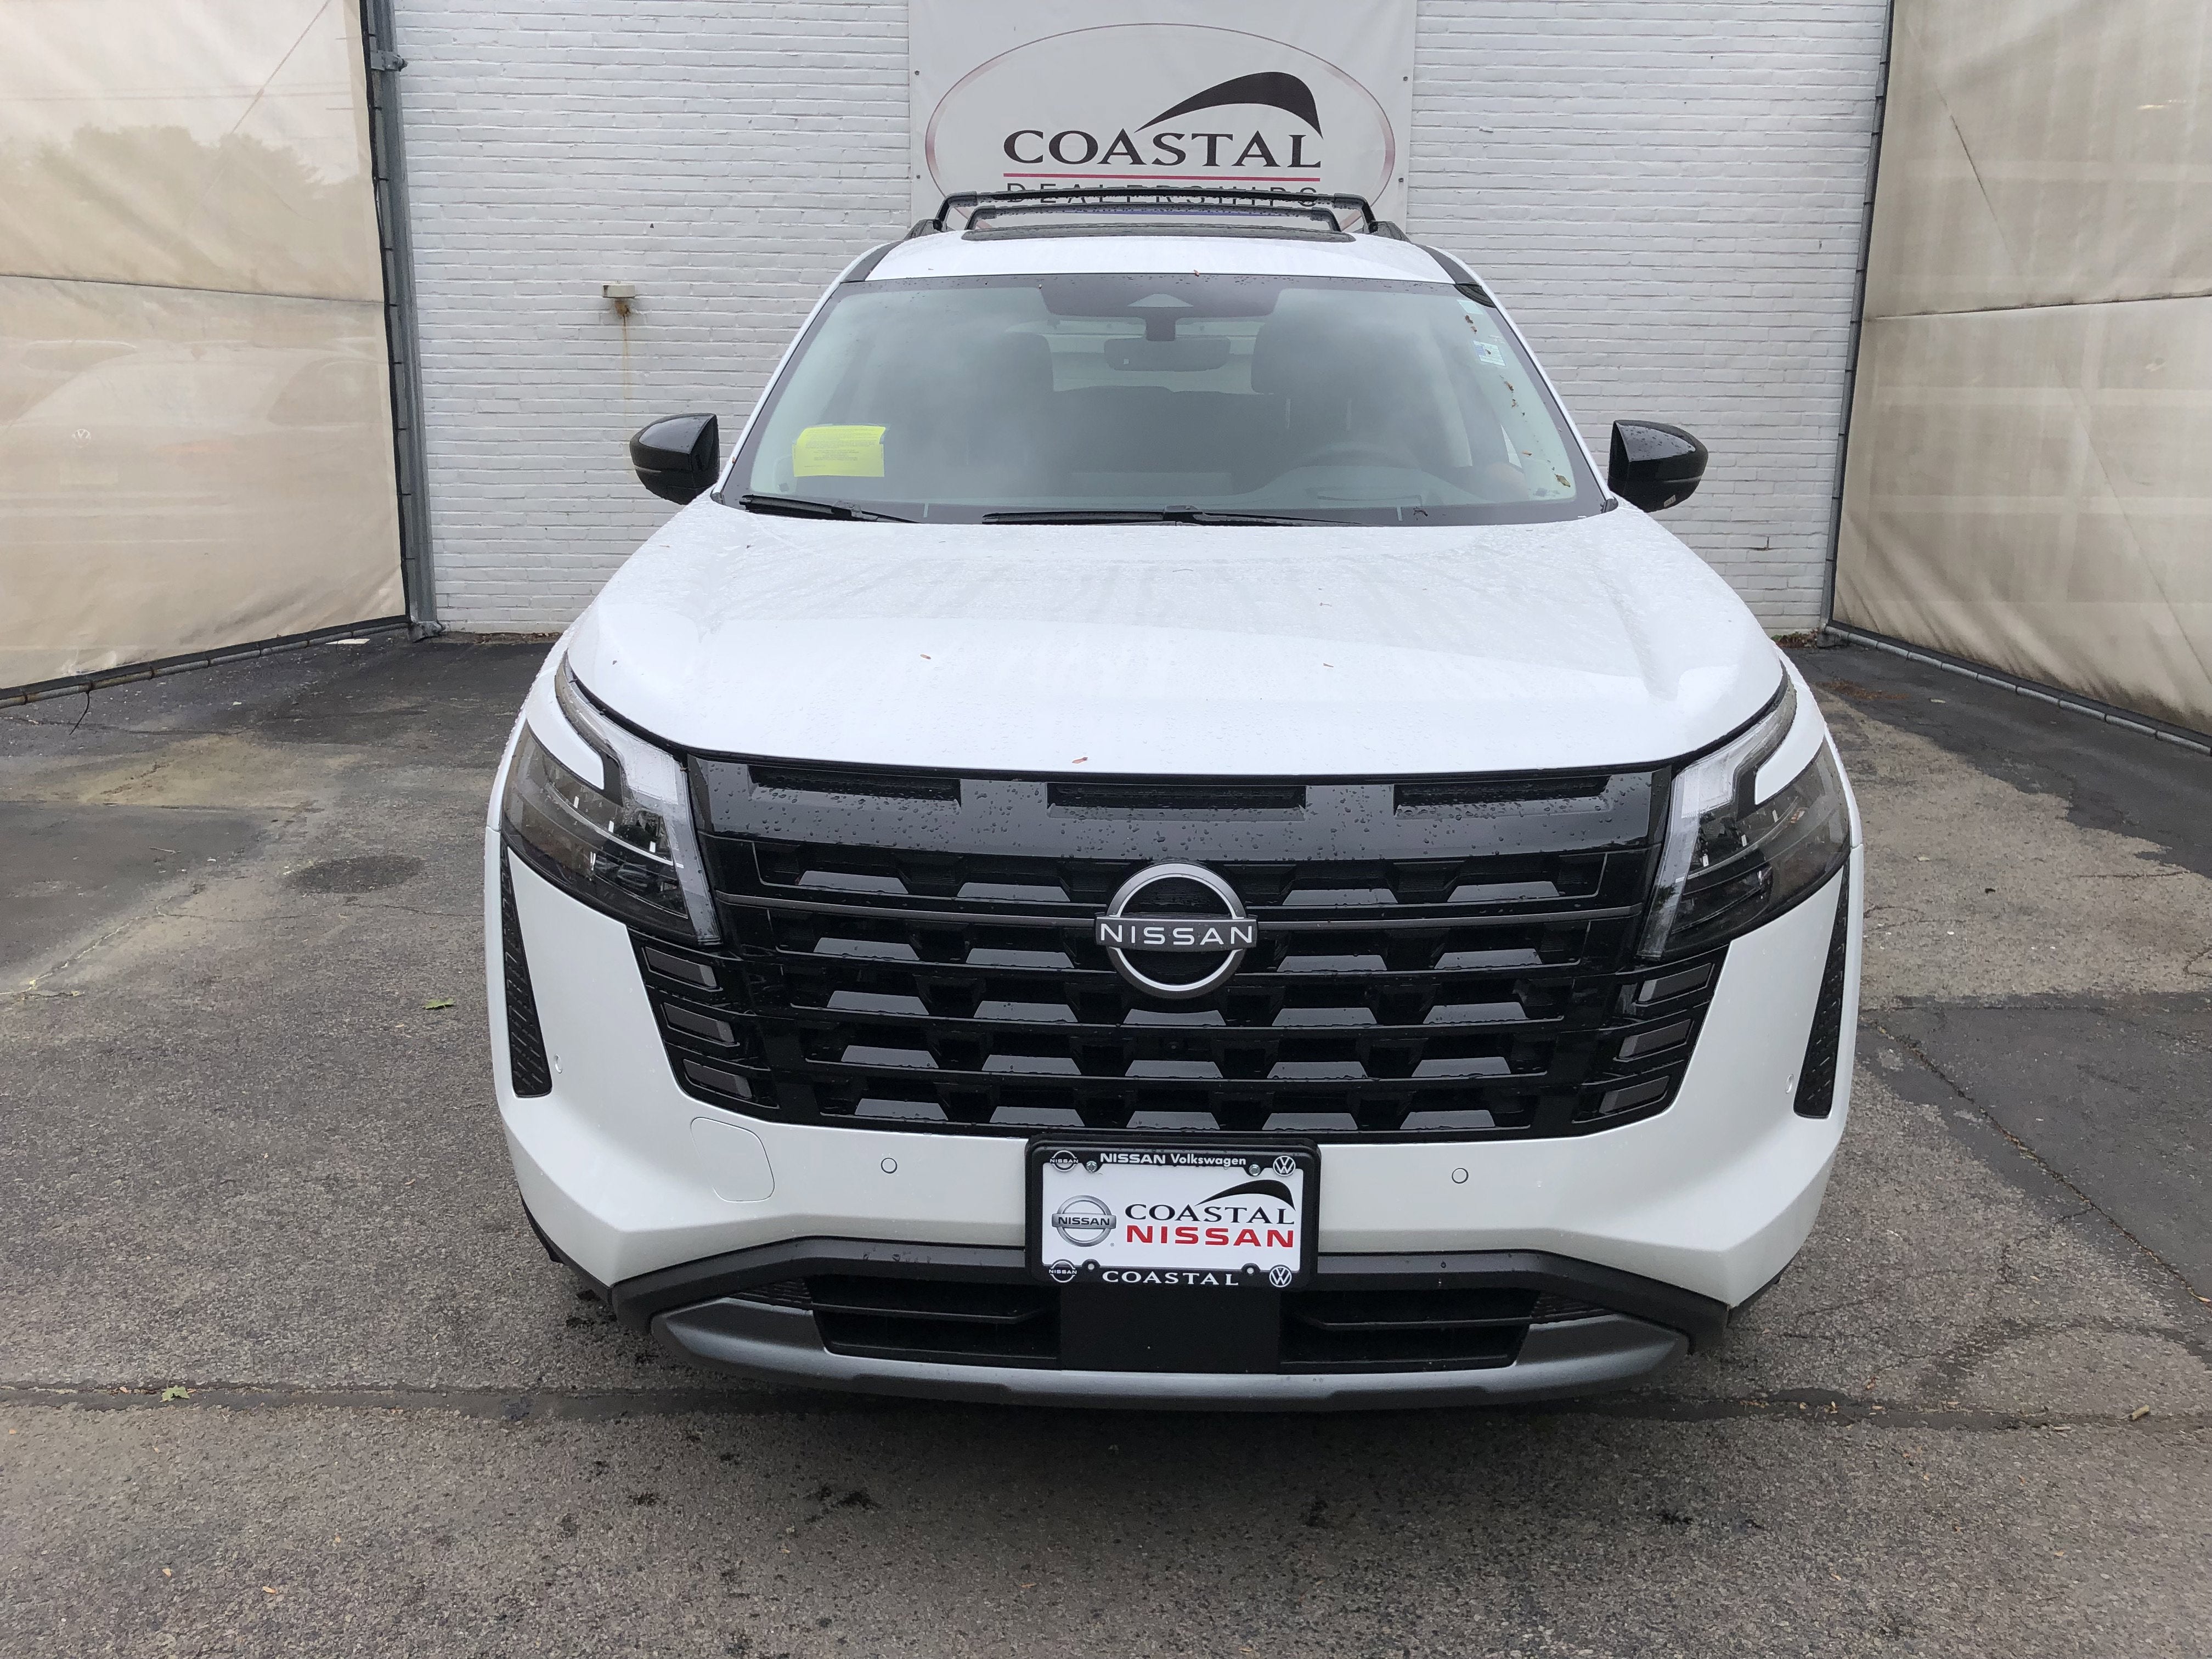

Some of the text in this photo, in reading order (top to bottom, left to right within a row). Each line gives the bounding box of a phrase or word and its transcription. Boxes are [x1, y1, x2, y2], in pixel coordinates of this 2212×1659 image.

[1003, 128, 1323, 168] COASTAL
[1101, 923, 1252, 945] NISSAN
[1100, 1153, 1246, 1167] NISSAN Volkswagen
[1058, 1216, 1110, 1226] NISSAN
[1125, 1204, 1295, 1224] COASTAL
[1126, 1225, 1293, 1248] NISSAN
[1102, 1271, 1239, 1286] COASTAL
